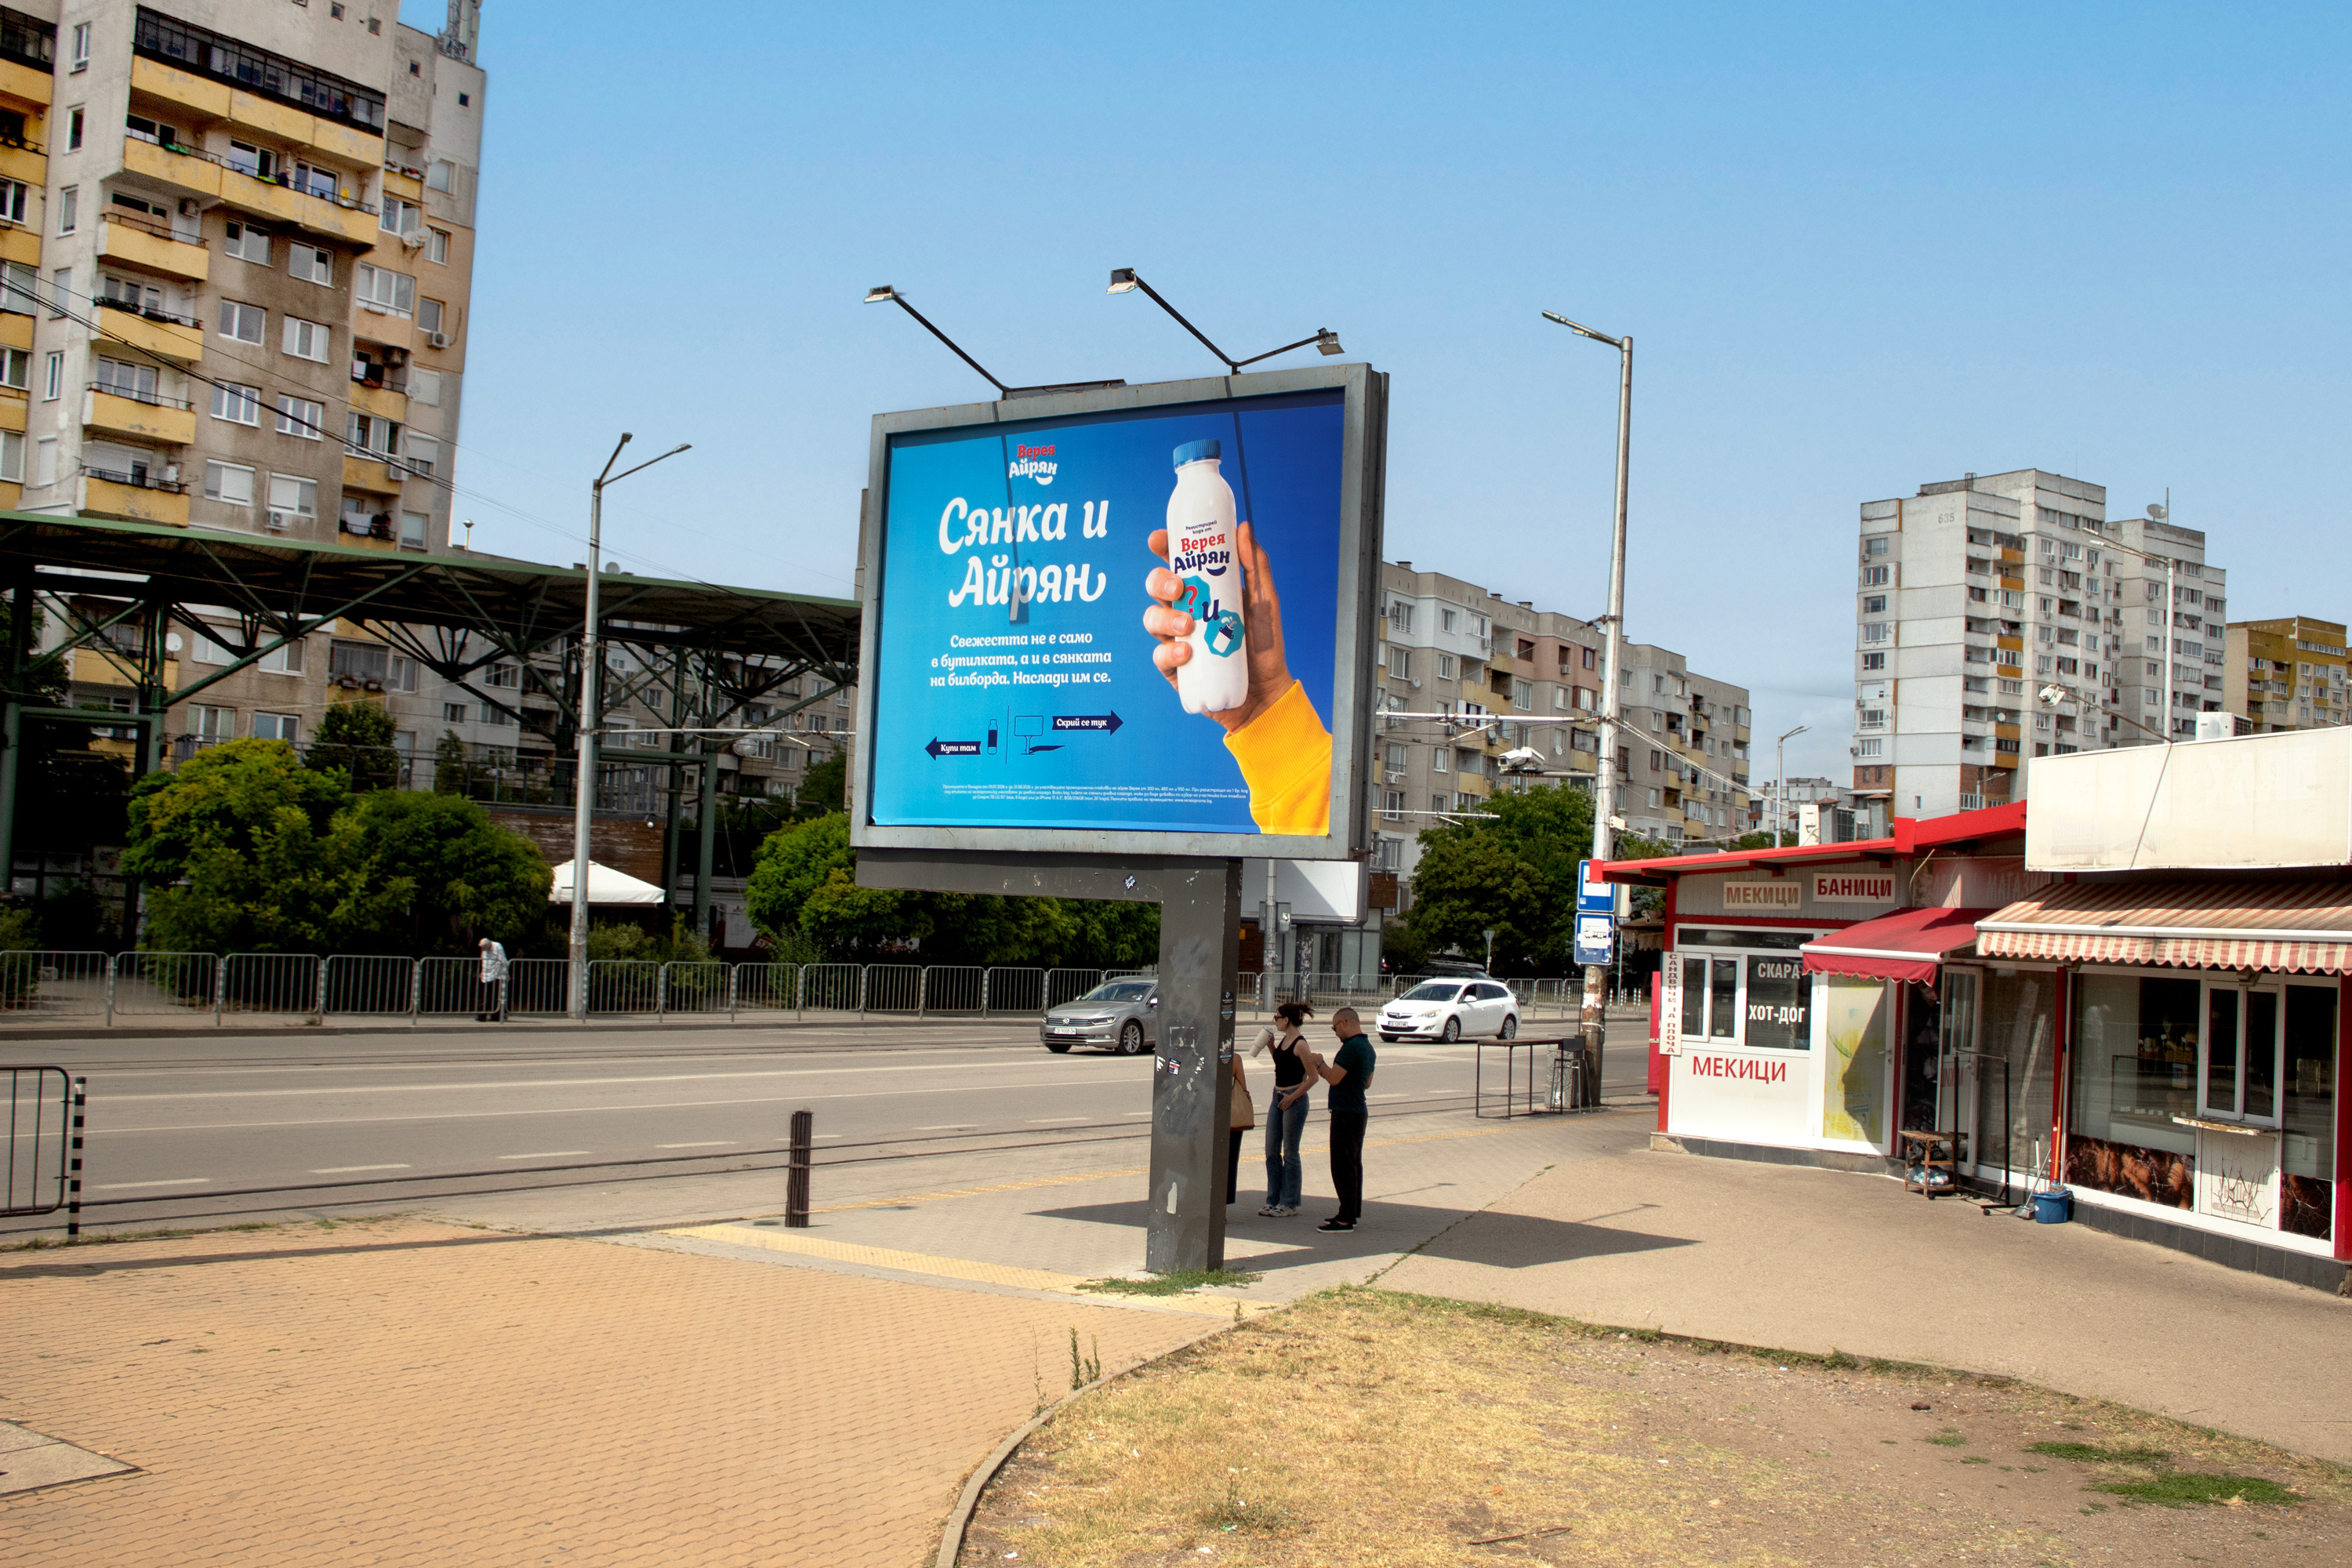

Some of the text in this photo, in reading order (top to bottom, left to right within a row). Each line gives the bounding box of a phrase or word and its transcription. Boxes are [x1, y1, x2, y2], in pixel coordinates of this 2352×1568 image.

[1017, 445, 1056, 460] Верея
[1009, 458, 1058, 479] Айрян
[938, 497, 1109, 554] Сянка и
[1181, 533, 1225, 553] Верея
[1174, 550, 1230, 574] Айрян
[948, 554, 1107, 622] Айрян
[1202, 599, 1220, 622] и
[950, 633, 1093, 648] Свежестта не е само
[931, 652, 1112, 671] в бутилката, а и в сянката
[930, 671, 1112, 689] на билборда. Наслади им се.
[1056, 718, 1080, 729] Скрий
[1091, 718, 1107, 729] тук
[941, 744, 977, 754] Купи там
[1726, 887, 1799, 907] МЕКИЦИ
[1817, 878, 1892, 900] БАНИЦИ
[1667, 954, 1678, 1003] САНДВИЧИ
[1758, 962, 1801, 979] СКАРА
[1748, 1004, 1806, 1025] ХОТ-ДОГ
[1693, 1055, 1786, 1084] МЕКИЦИ
